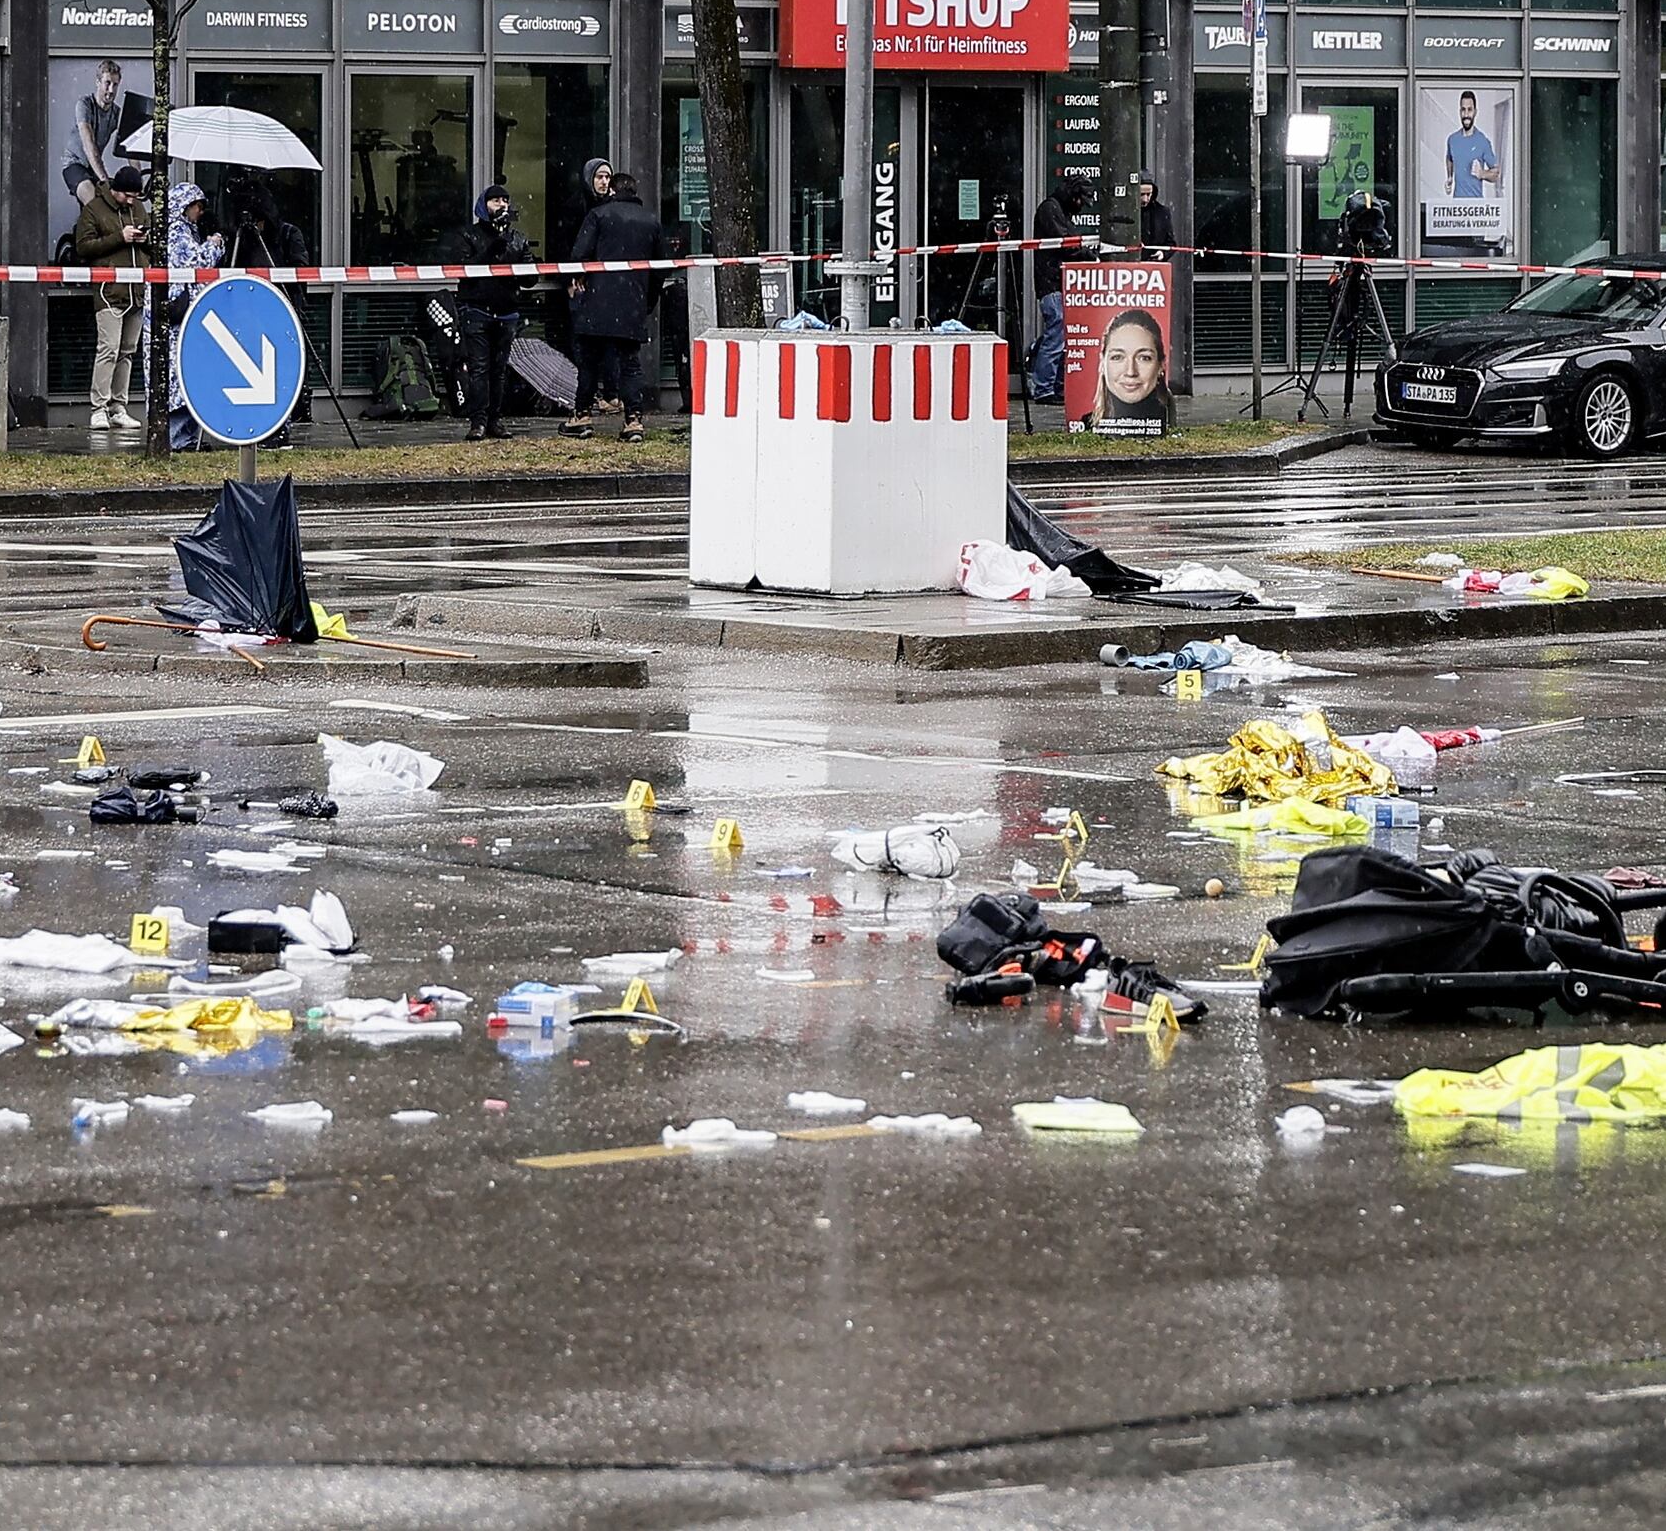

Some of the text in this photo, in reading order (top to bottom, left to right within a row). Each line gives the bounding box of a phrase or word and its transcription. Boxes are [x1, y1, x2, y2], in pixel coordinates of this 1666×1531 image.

[206, 11, 307, 28] DARWIN FITNESS
[367, 13, 456, 33] PELOTON
[516, 17, 581, 35] cardiostrong
[925, 35, 944, 53] für
[948, 36, 1028, 54] Heimfitness
[1312, 31, 1382, 50] KETTLER
[1423, 37, 1505, 48] BODYCRAFT
[1533, 37, 1611, 52] SCHWINN
[1433, 204, 1501, 217] FITNESSGERÄTE
[1433, 220, 1465, 228] BERATUNG
[1472, 220, 1500, 228] VERKAUF
[1065, 269, 1166, 292] PHILIPPA
[1065, 291, 1165, 308] SIGL-GLÖCKNER
[1081, 325, 1089, 334] es
[1406, 385, 1455, 402] STA PA 135
[1069, 421, 1085, 433] SPD
[1184, 674, 1194, 688] 5
[633, 785, 641, 801] 6
[717, 823, 728, 841] 9
[138, 920, 162, 941] 12
